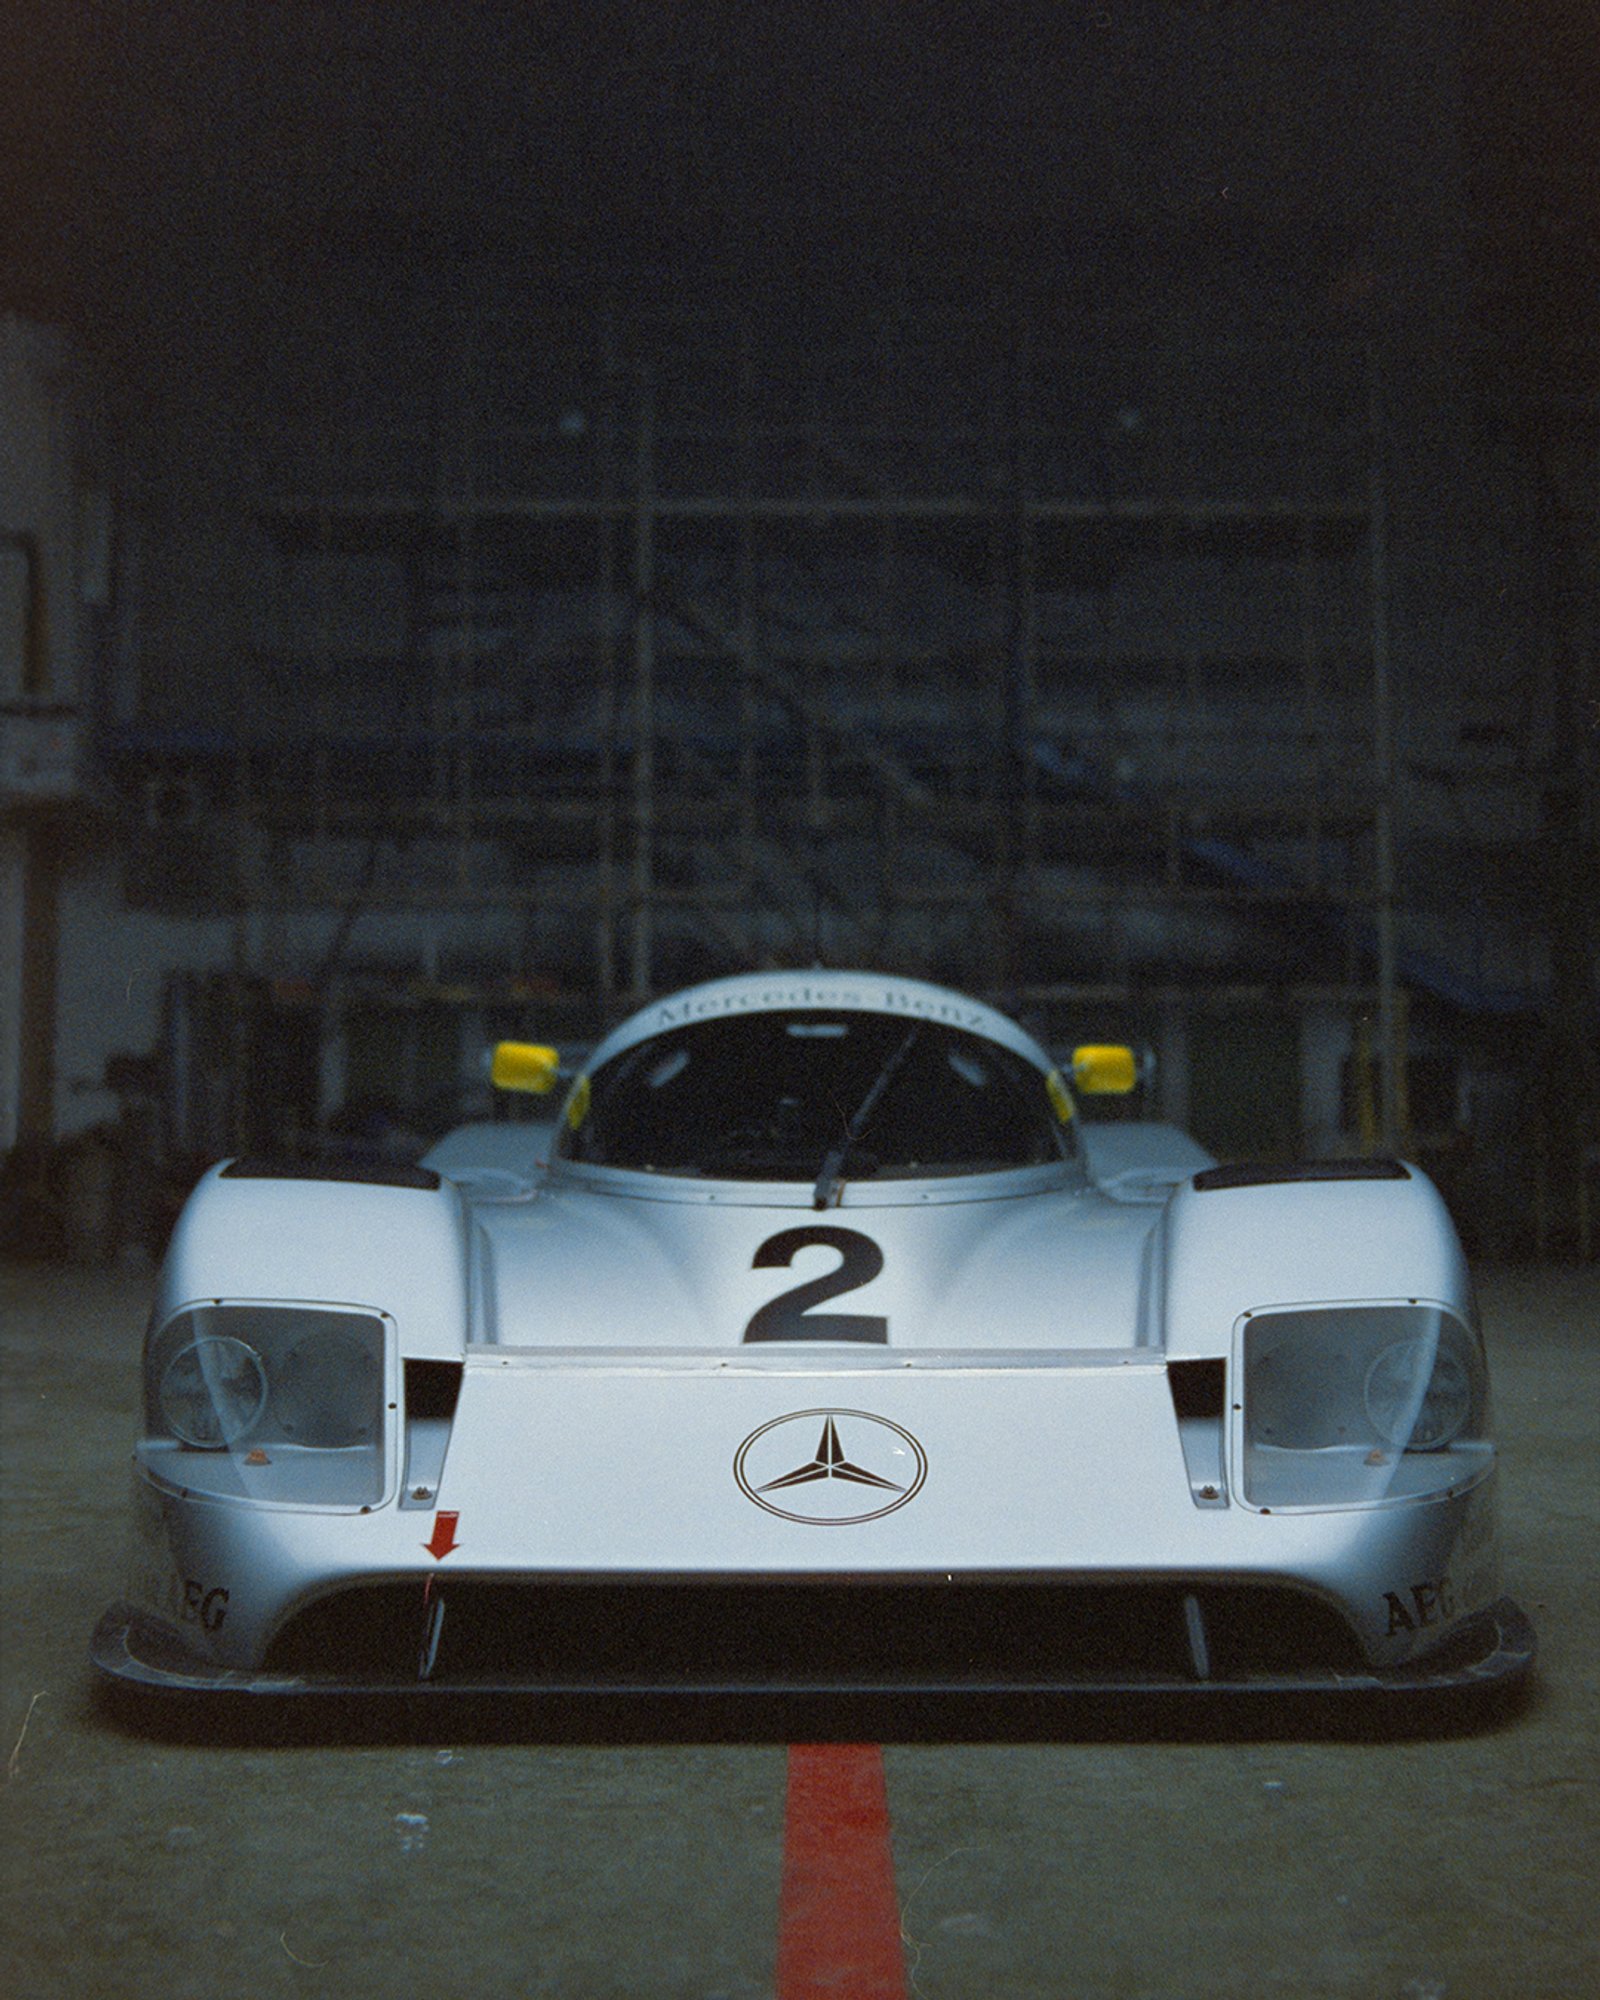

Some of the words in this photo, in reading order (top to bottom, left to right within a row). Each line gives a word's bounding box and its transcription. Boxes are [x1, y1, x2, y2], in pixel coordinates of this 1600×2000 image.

[658, 987, 861, 1027] Mercedes
[885, 990, 986, 1029] Benz
[742, 1225, 889, 1344] 2
